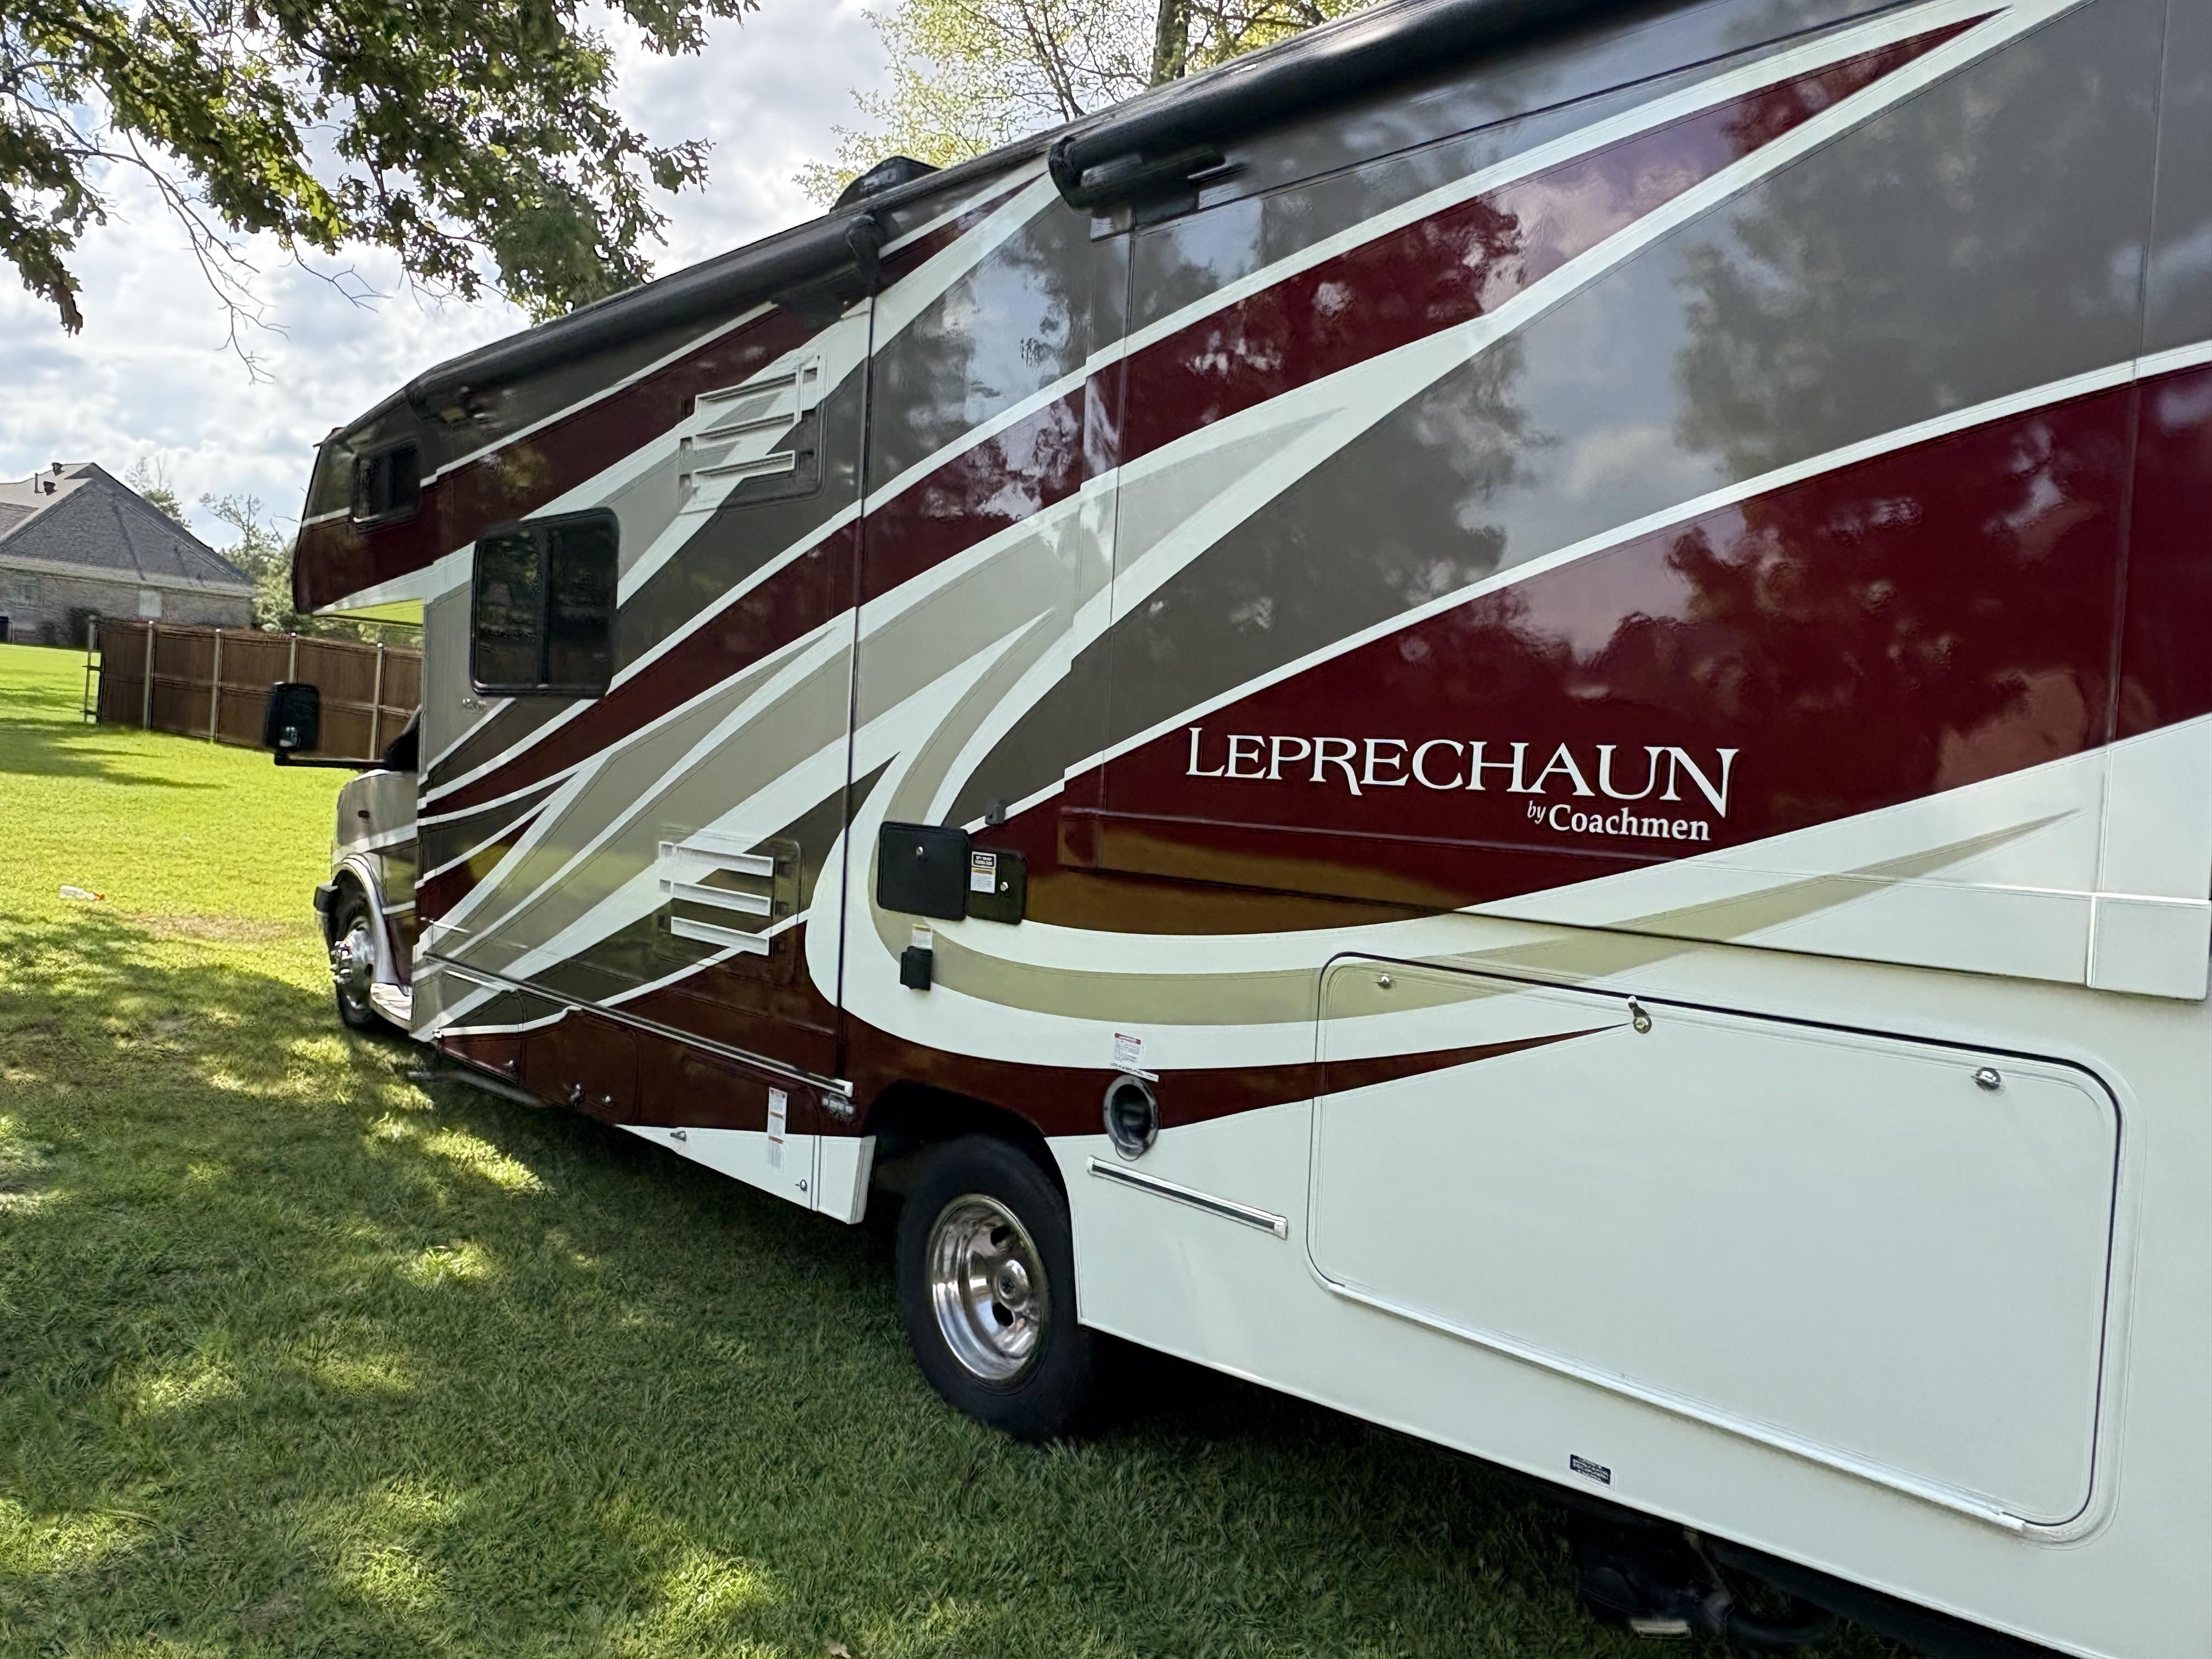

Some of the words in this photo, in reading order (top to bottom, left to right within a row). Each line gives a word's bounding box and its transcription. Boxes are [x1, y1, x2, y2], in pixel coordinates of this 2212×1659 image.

[1186, 727, 1740, 819] LEPRECHAUN
[1527, 800, 1547, 825] by
[1549, 804, 1712, 841] Coachmen
